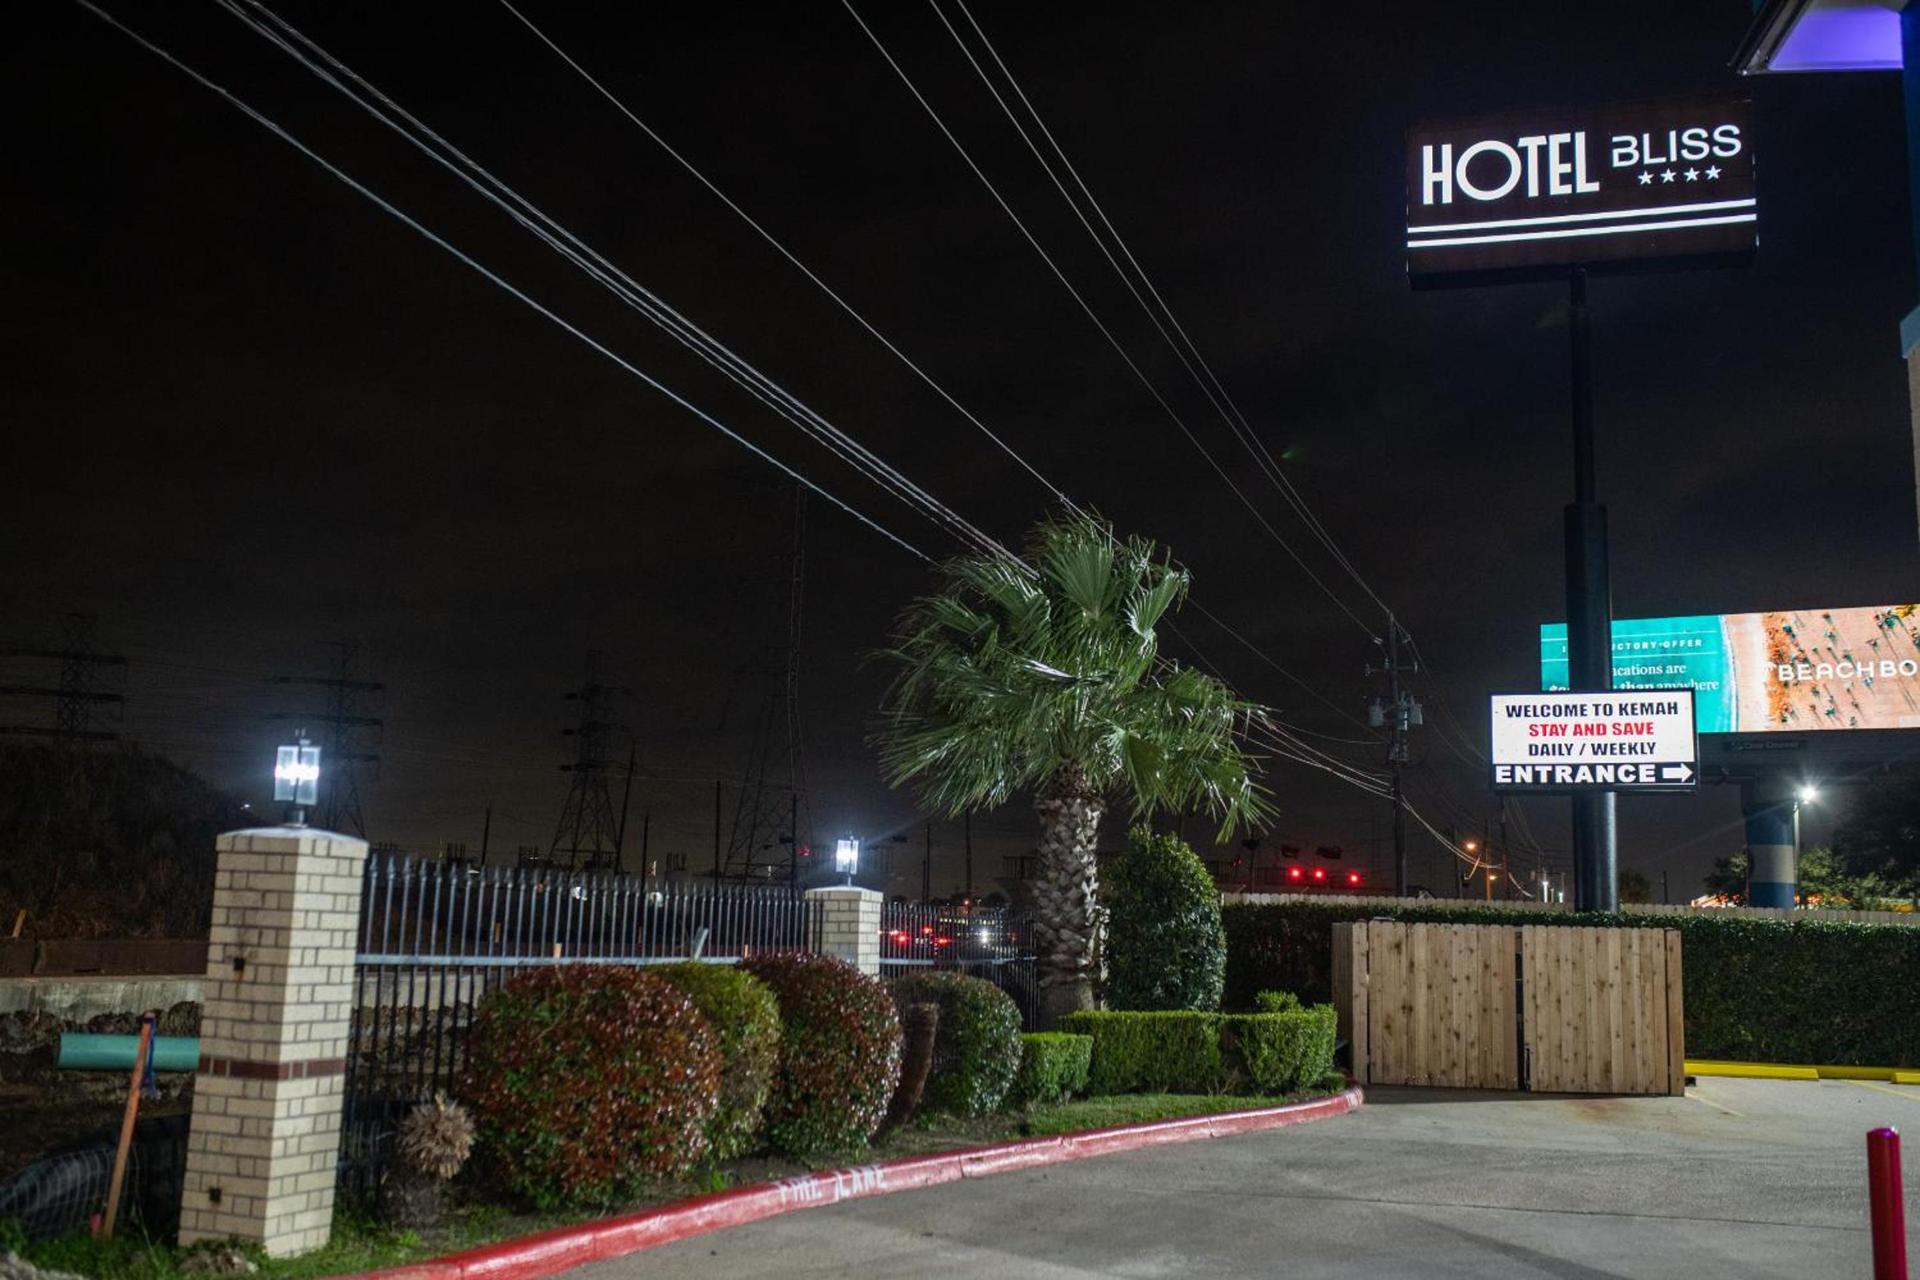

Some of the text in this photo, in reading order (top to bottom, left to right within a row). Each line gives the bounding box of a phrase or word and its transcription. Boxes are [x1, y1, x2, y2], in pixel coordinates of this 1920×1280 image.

[1422, 124, 1742, 205] HOTEL BLISS
[1662, 639, 1703, 648] OFFER
[1665, 663, 1687, 674] are
[1505, 702, 1679, 718] WELCOME TO KEMAH
[1528, 721, 1655, 737] STAY AND SAVE
[1528, 743, 1574, 756] DAILY
[1590, 742, 1657, 756] WEEKLY
[1495, 763, 1657, 784] ENTRANCE
